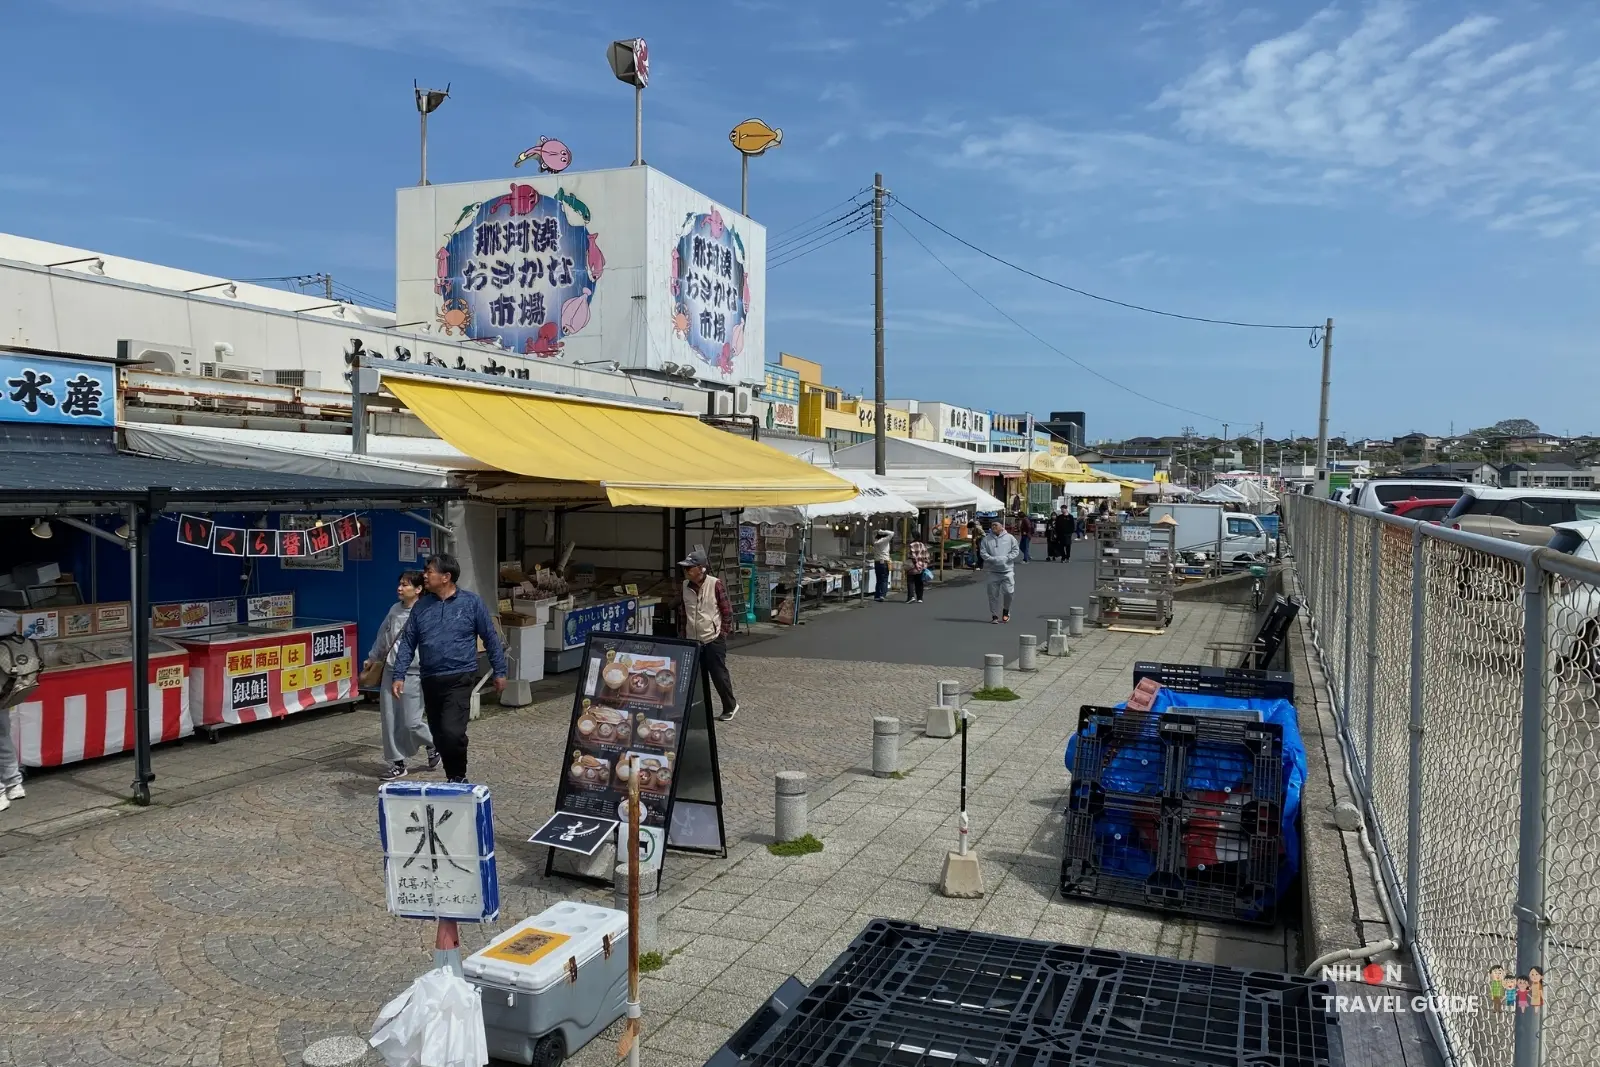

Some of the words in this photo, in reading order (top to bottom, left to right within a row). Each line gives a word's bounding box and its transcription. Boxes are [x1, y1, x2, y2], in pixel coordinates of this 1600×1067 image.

[475, 218, 561, 256] 那珂湊
[463, 256, 574, 291] おさかな
[692, 235, 732, 280] 那珂湊
[489, 291, 546, 326] 市場
[686, 268, 738, 312] おさかな
[700, 307, 726, 344] 市場
[0, 370, 103, 417] 水産
[185, 518, 355, 555] いくら醤油漬
[228, 649, 299, 672] 看板商品は
[313, 633, 344, 657] 銀鮭
[233, 678, 268, 704] 銀鮭
[402, 804, 474, 874] 氷
